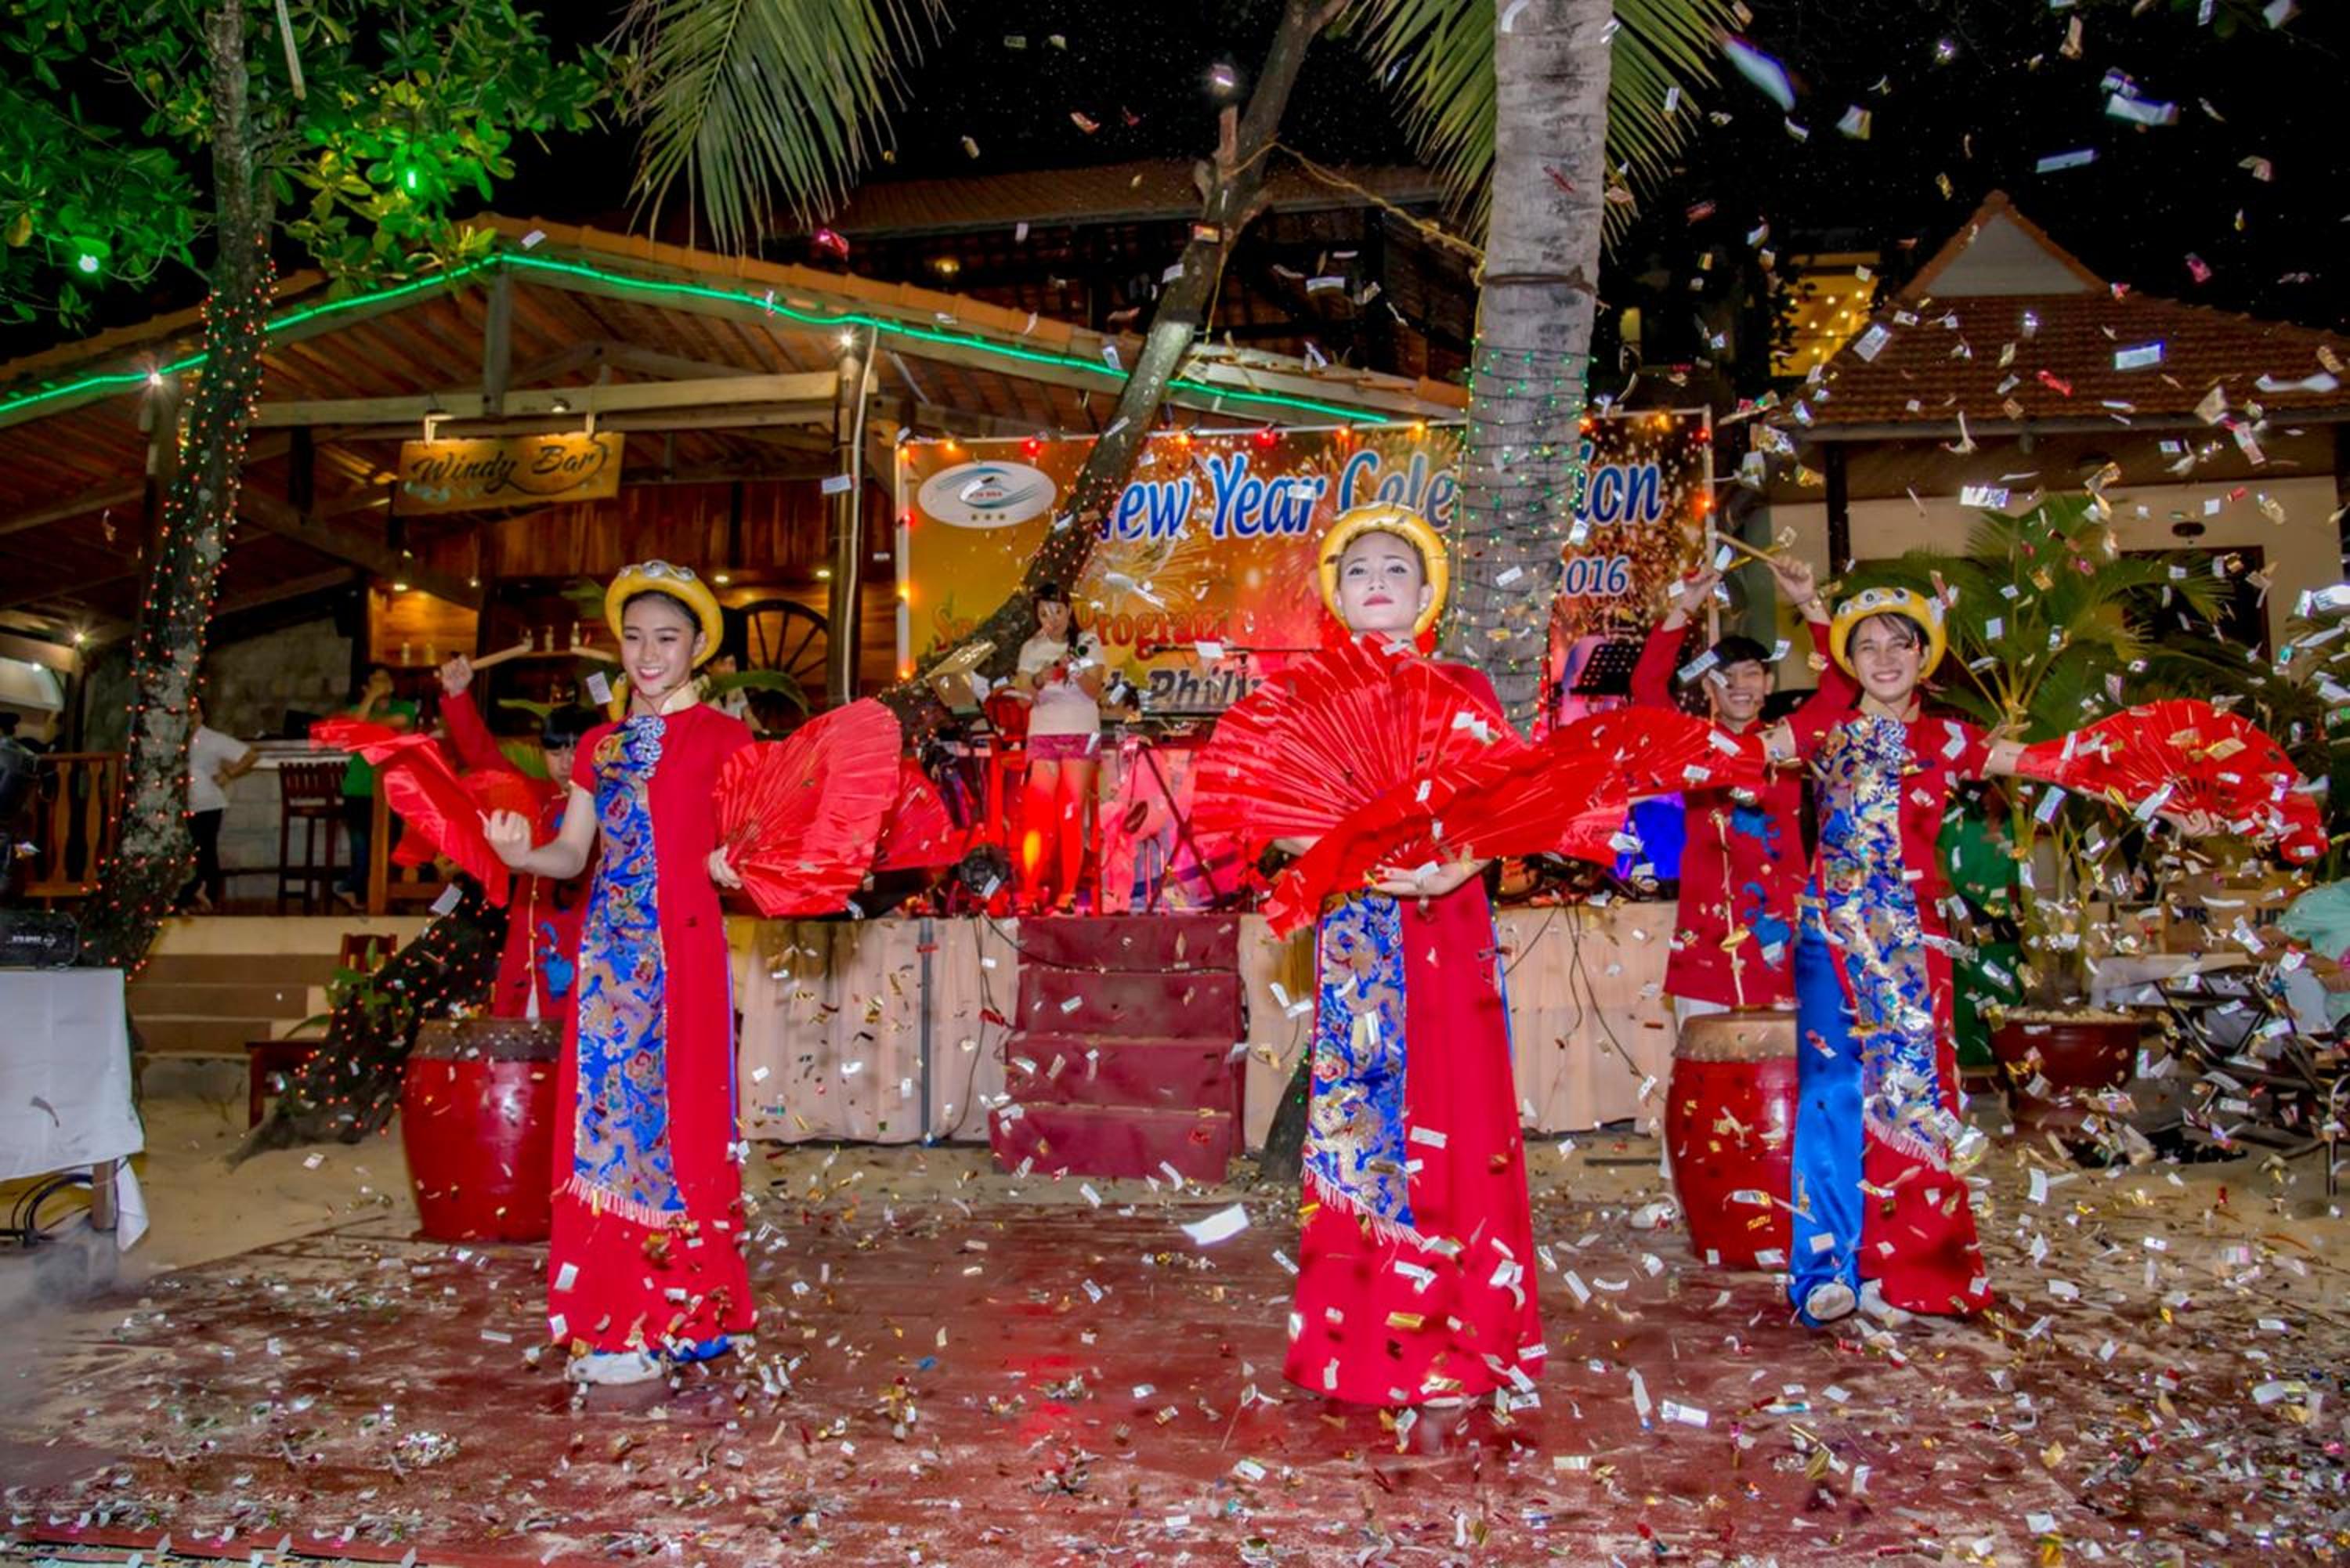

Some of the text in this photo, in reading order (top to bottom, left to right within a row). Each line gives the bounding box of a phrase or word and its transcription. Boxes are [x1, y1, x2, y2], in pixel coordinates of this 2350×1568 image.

[410, 443, 595, 494] Windy Bar
[1099, 479, 1193, 542] ew
[1207, 452, 1326, 539] Year
[1554, 555, 1630, 597] 016
[1148, 667, 1263, 709] Phili
